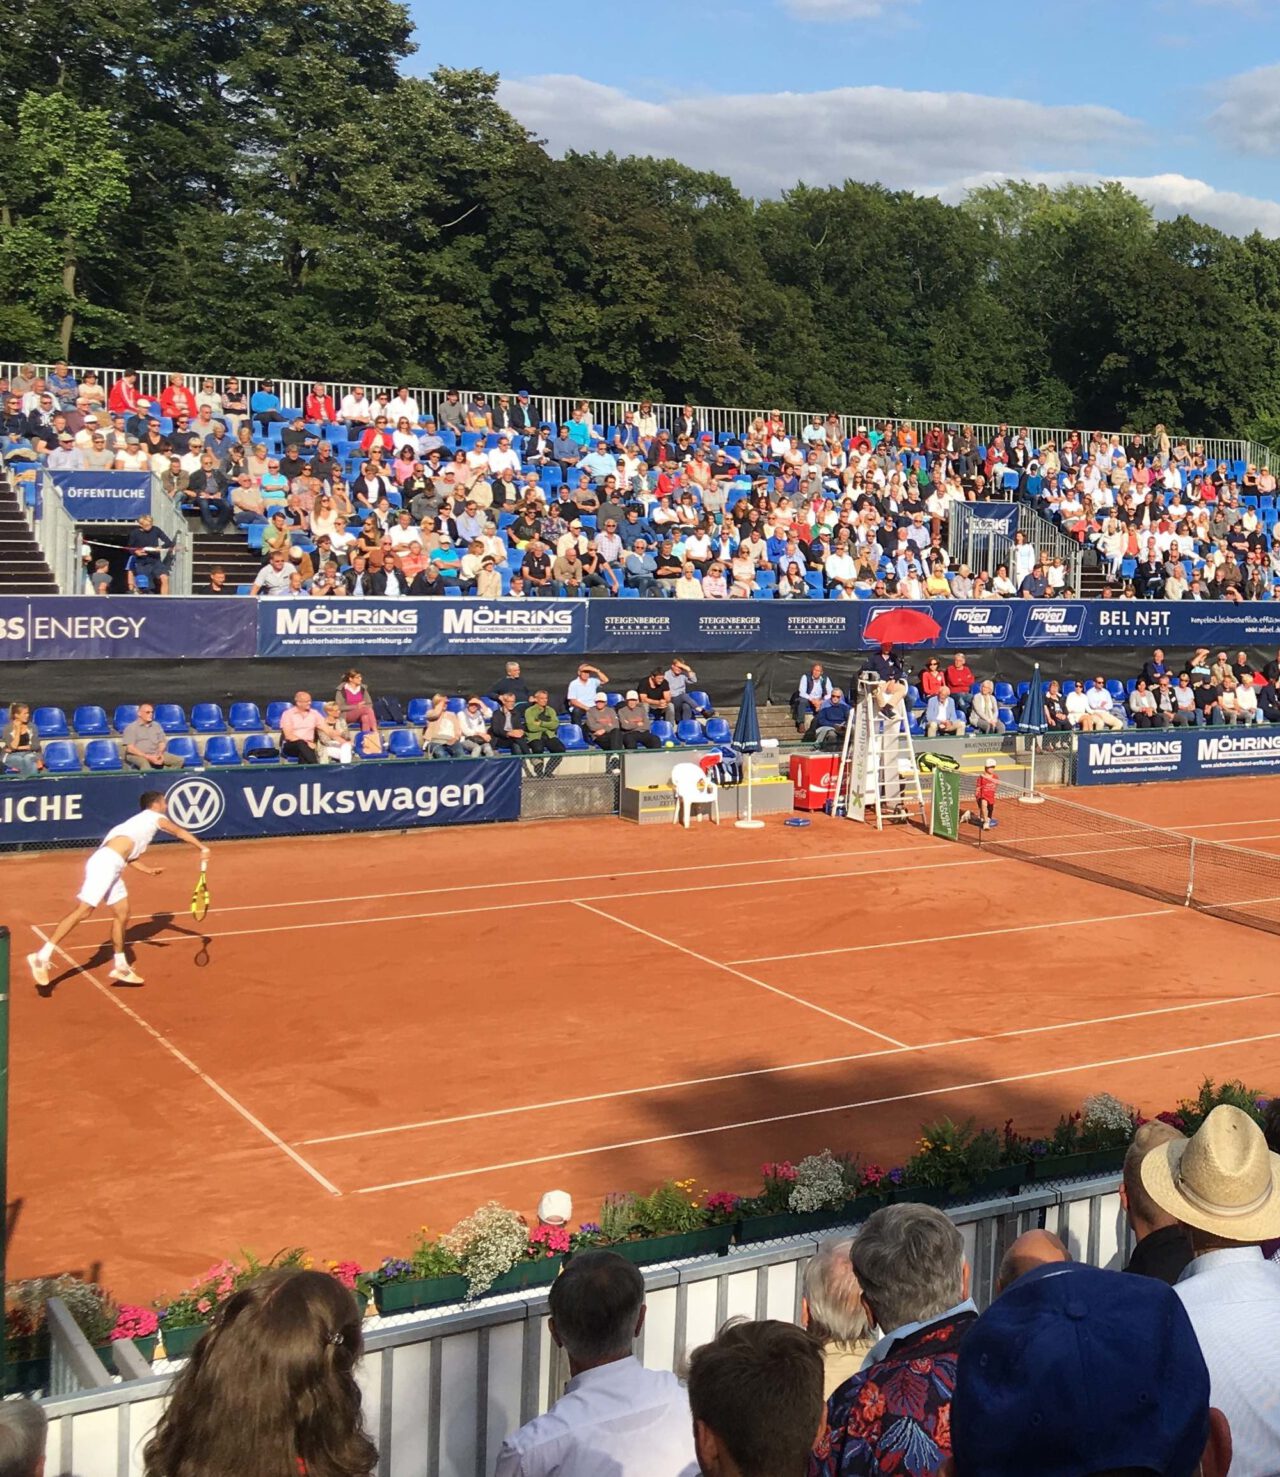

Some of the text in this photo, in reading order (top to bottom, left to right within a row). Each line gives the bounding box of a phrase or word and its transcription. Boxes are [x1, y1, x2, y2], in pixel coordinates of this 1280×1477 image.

[67, 486, 146, 498] ÖFFENTLICHE
[276, 605, 418, 635] MÖHRING
[443, 606, 573, 634] MÖHRING
[954, 608, 988, 622] hoyer
[1031, 608, 1064, 622] hoyer
[1100, 611, 1130, 626] BEL
[35, 616, 147, 639] ENERGY
[1089, 740, 1182, 766] MÖHRING
[0, 793, 83, 823] ICHE
[243, 782, 485, 817] Volkswagen
